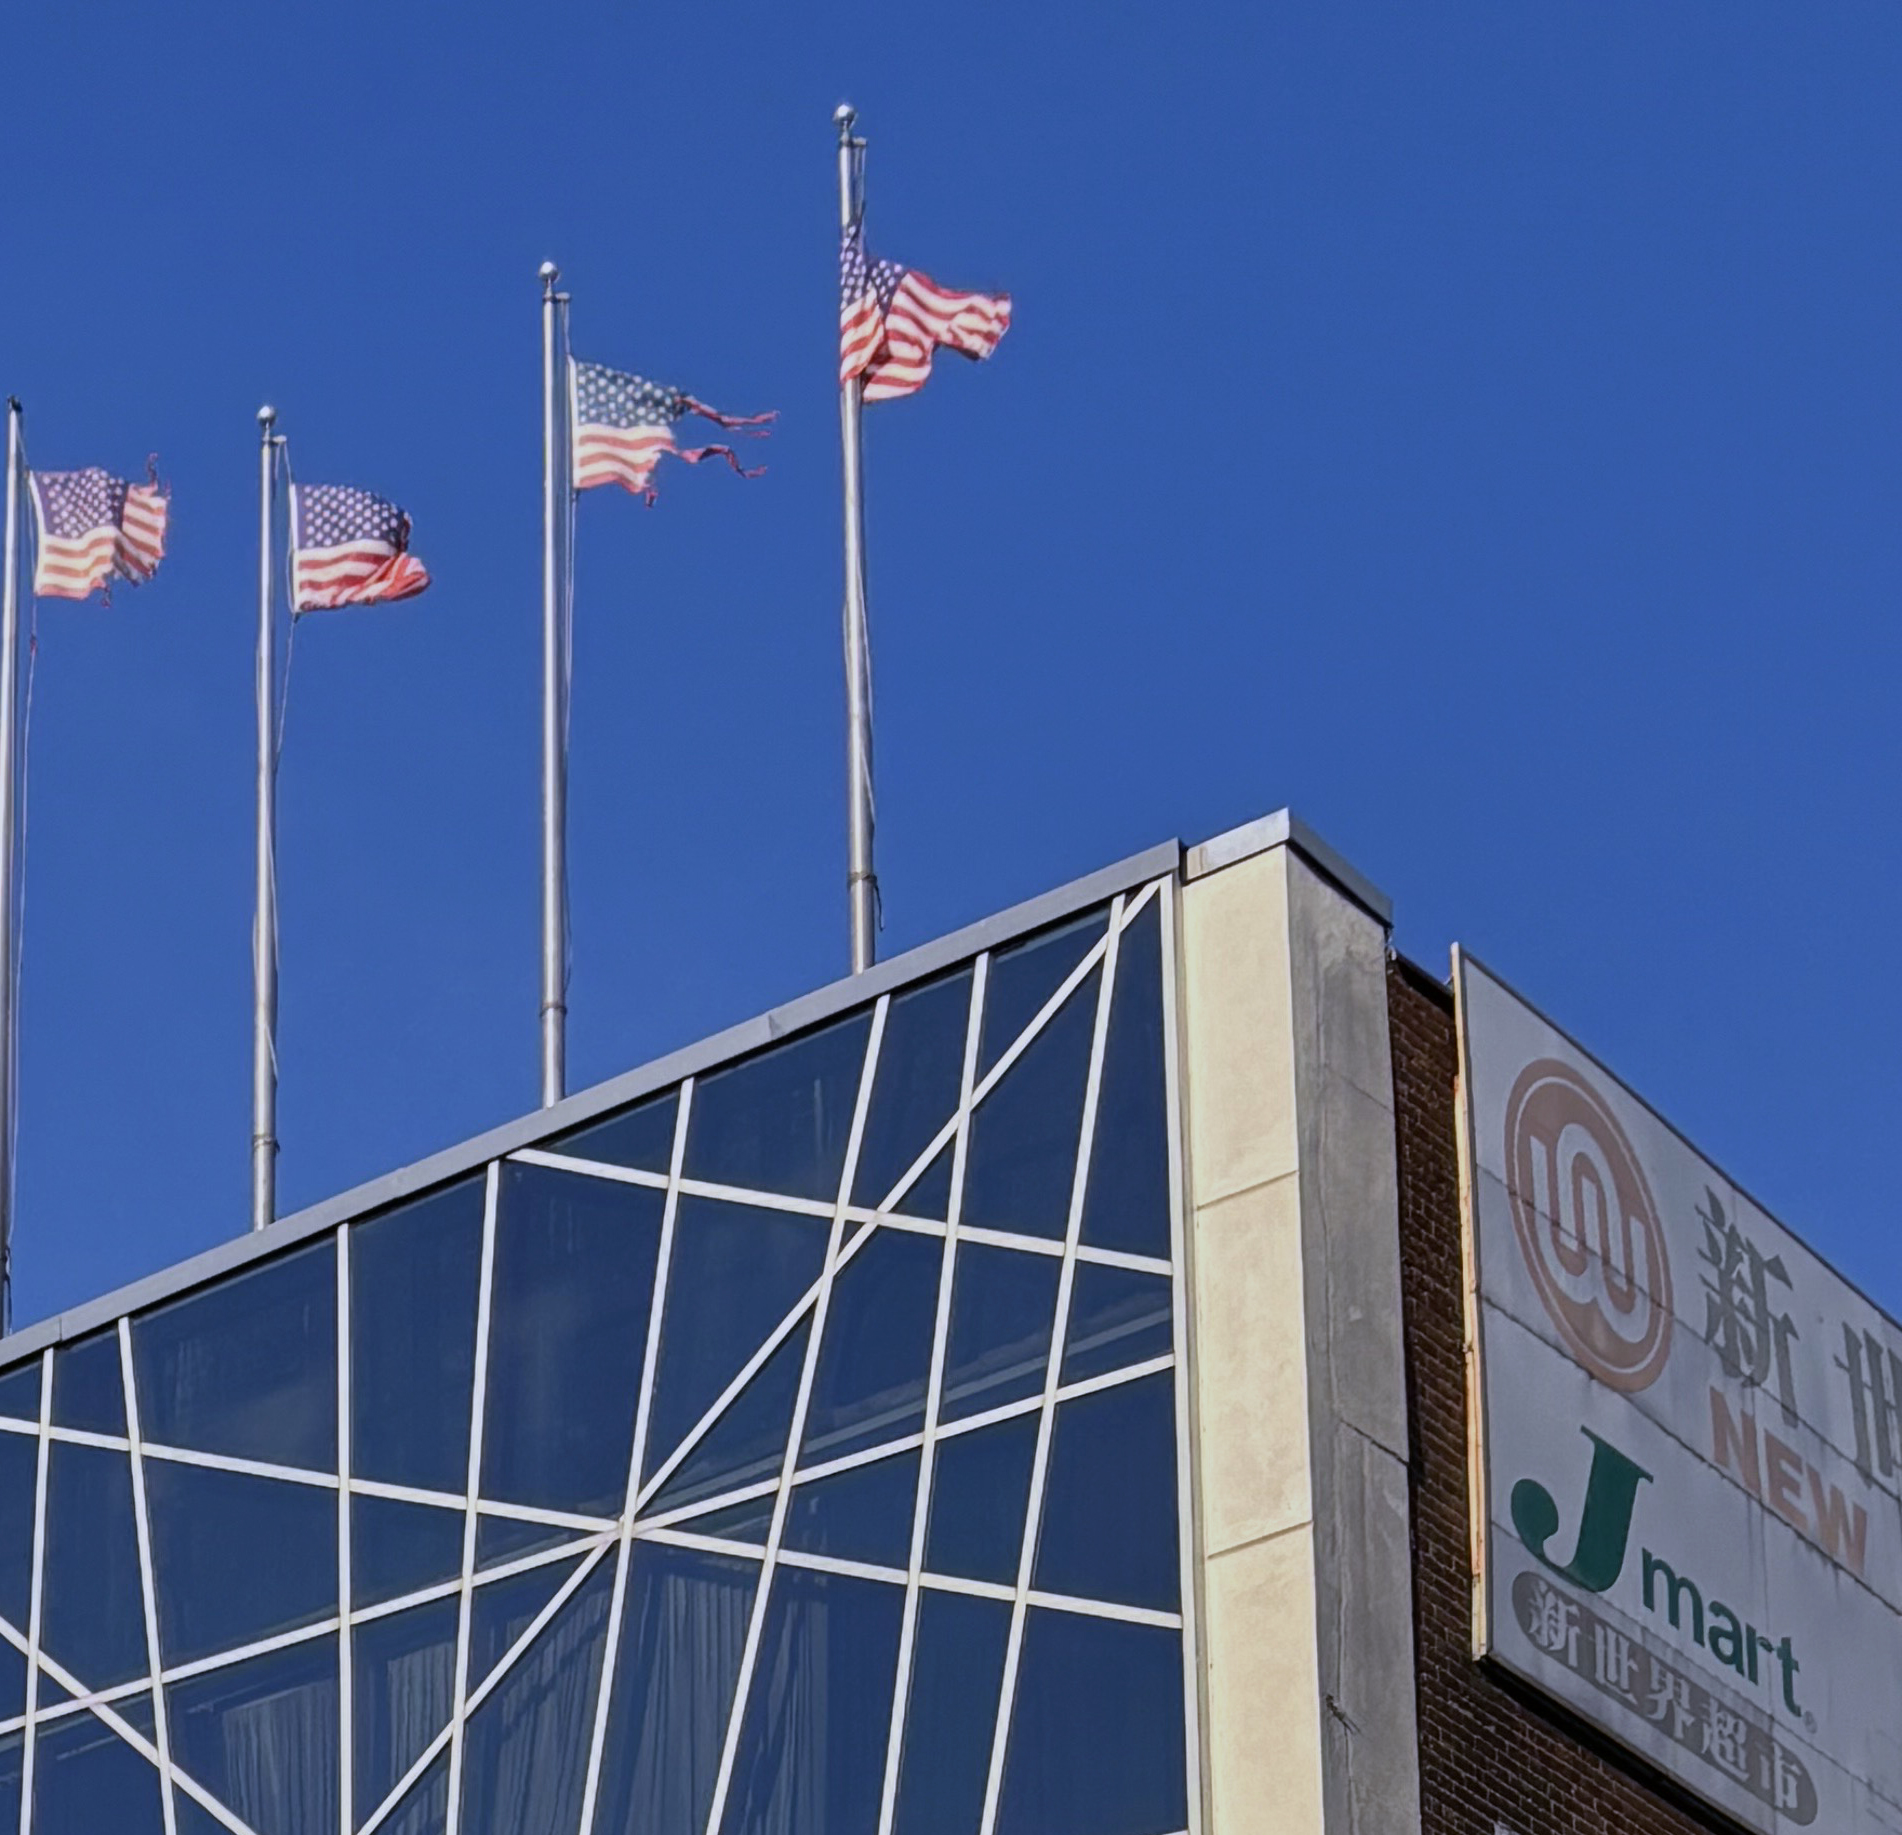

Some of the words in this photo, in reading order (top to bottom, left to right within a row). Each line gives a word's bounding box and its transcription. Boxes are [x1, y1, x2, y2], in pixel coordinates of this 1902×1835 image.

[1510, 1425, 1802, 1718] Jmart
[1709, 1386, 1868, 1578] NEW
[1528, 1578, 1802, 1813] 新世界超市
